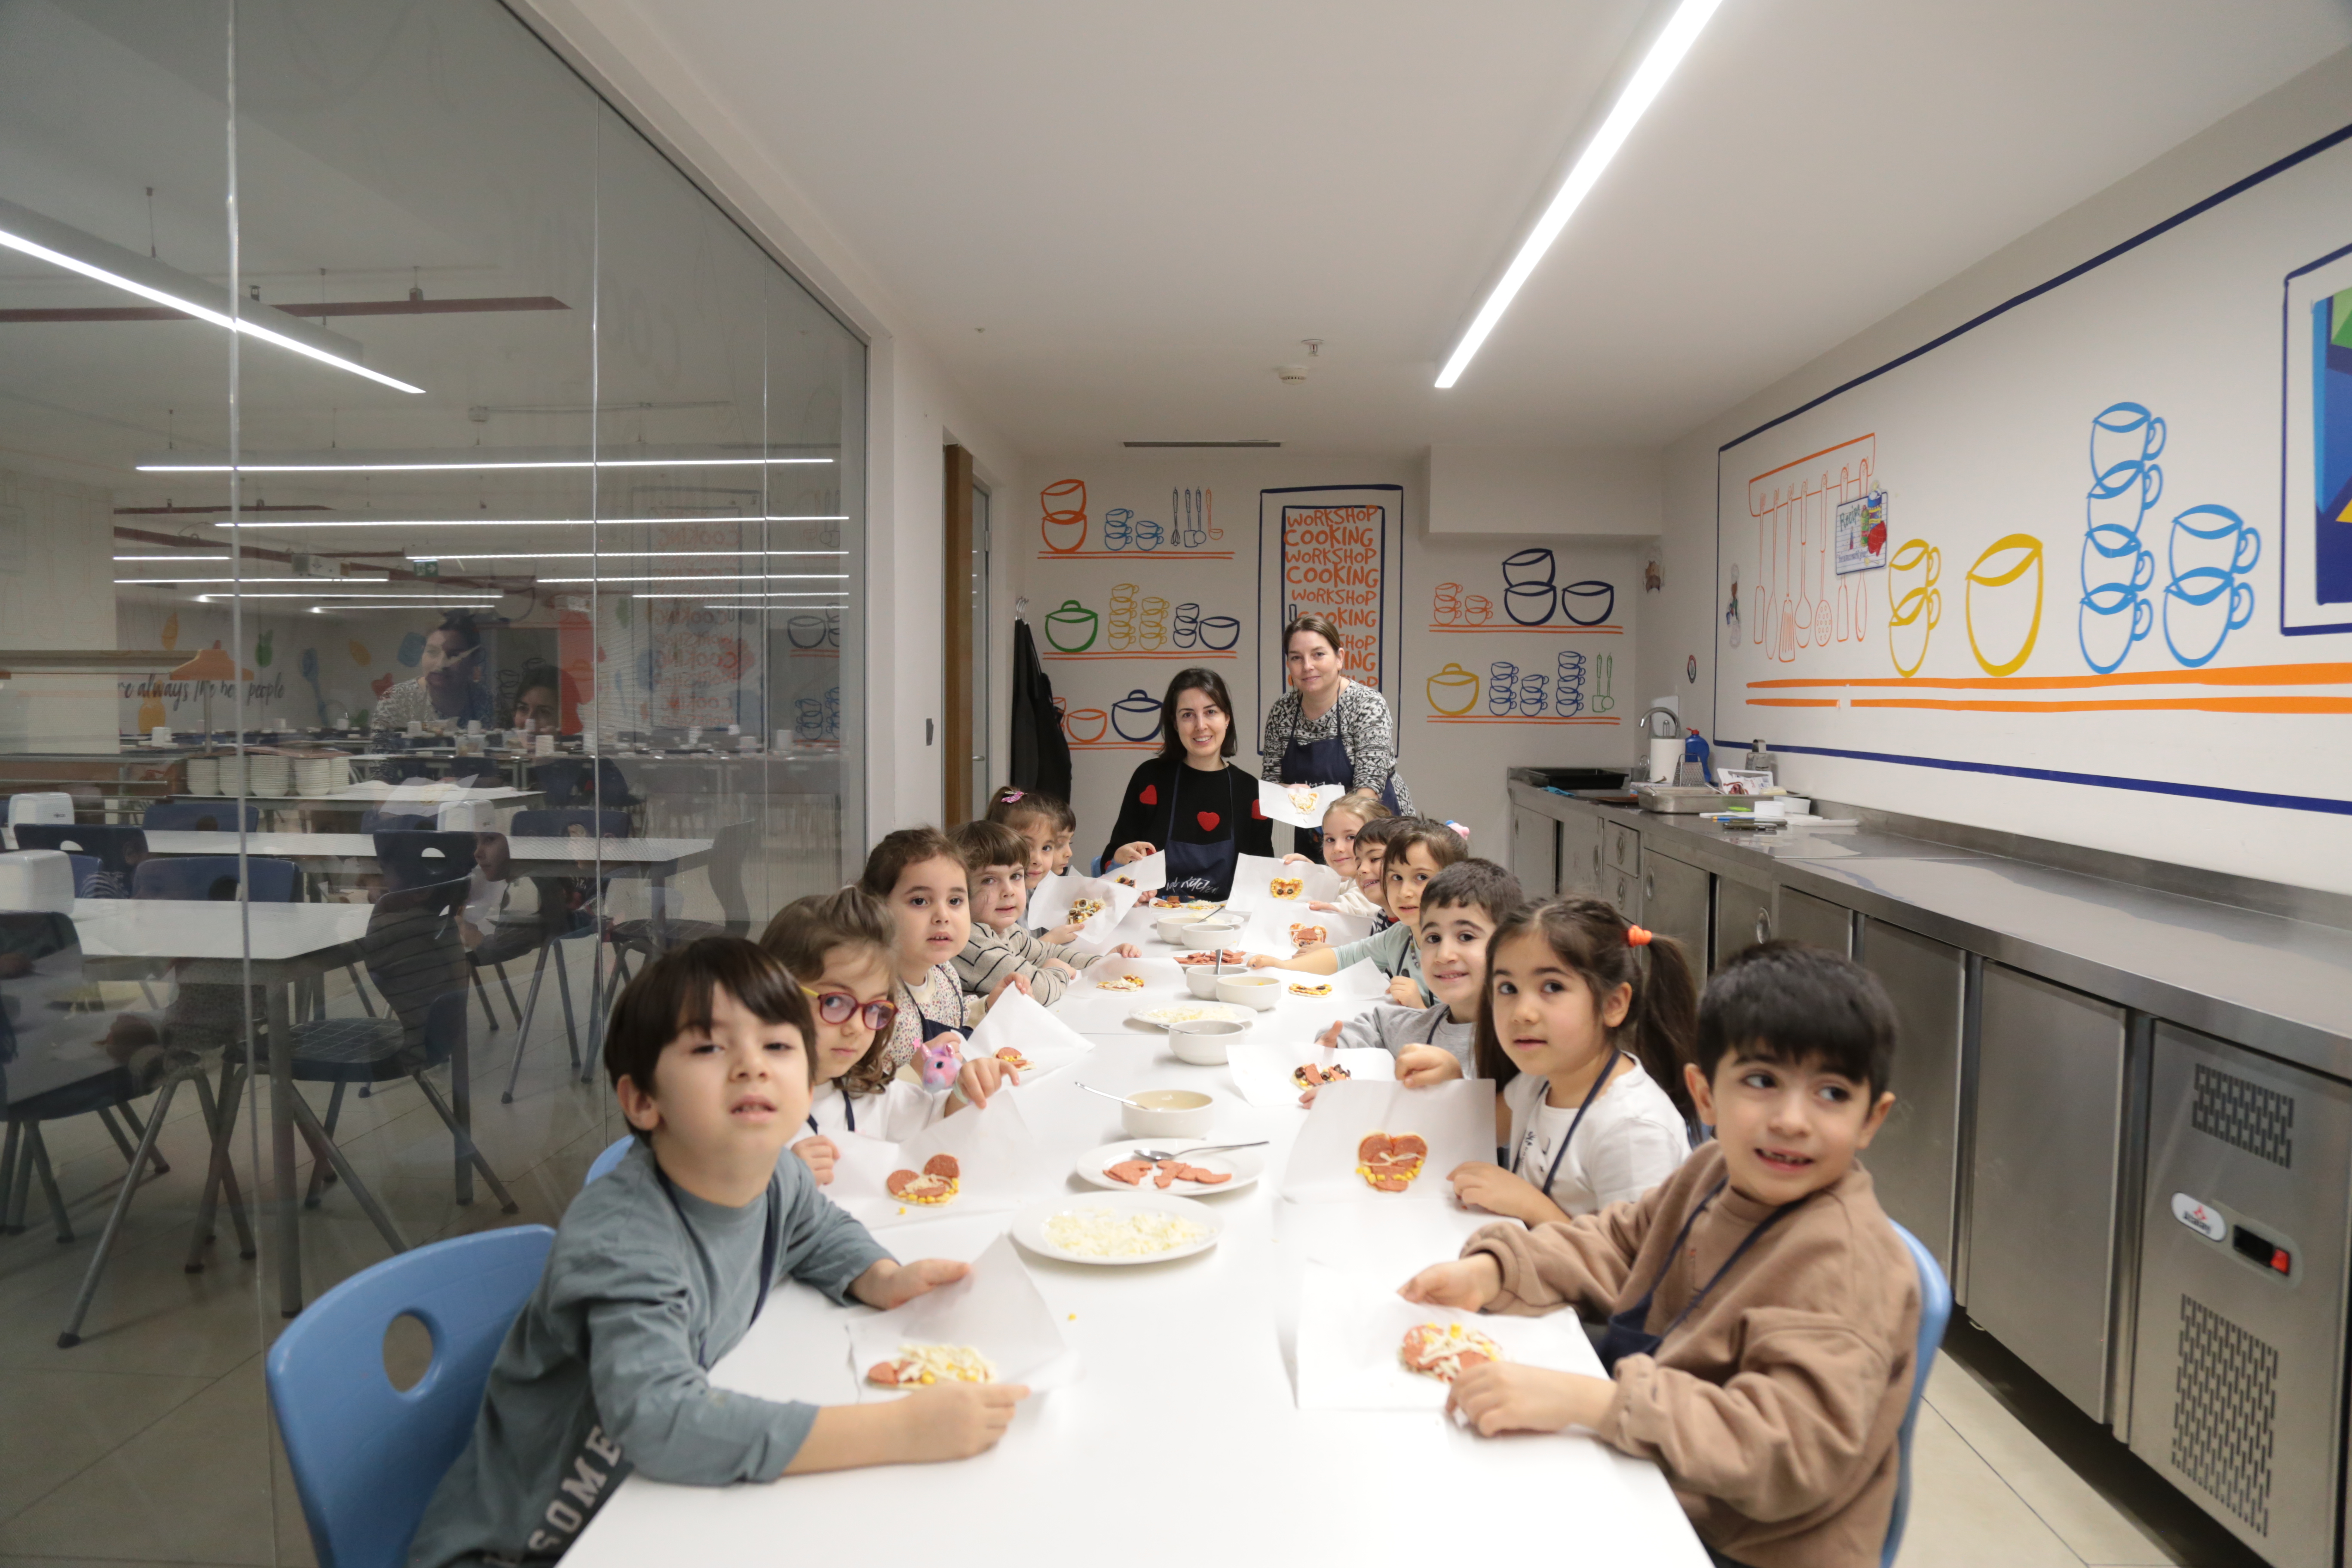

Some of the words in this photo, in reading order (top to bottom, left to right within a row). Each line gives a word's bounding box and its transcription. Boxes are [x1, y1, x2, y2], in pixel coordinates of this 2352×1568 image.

[1287, 505, 1378, 527] WORKSHOP
[1283, 524, 1374, 549] COOKING
[1285, 547, 1377, 566] WORKSHOP
[1286, 563, 1379, 588] COOKING
[1292, 588, 1377, 606] WORKSHOP
[137, 673, 189, 711] always
[245, 672, 284, 706] people
